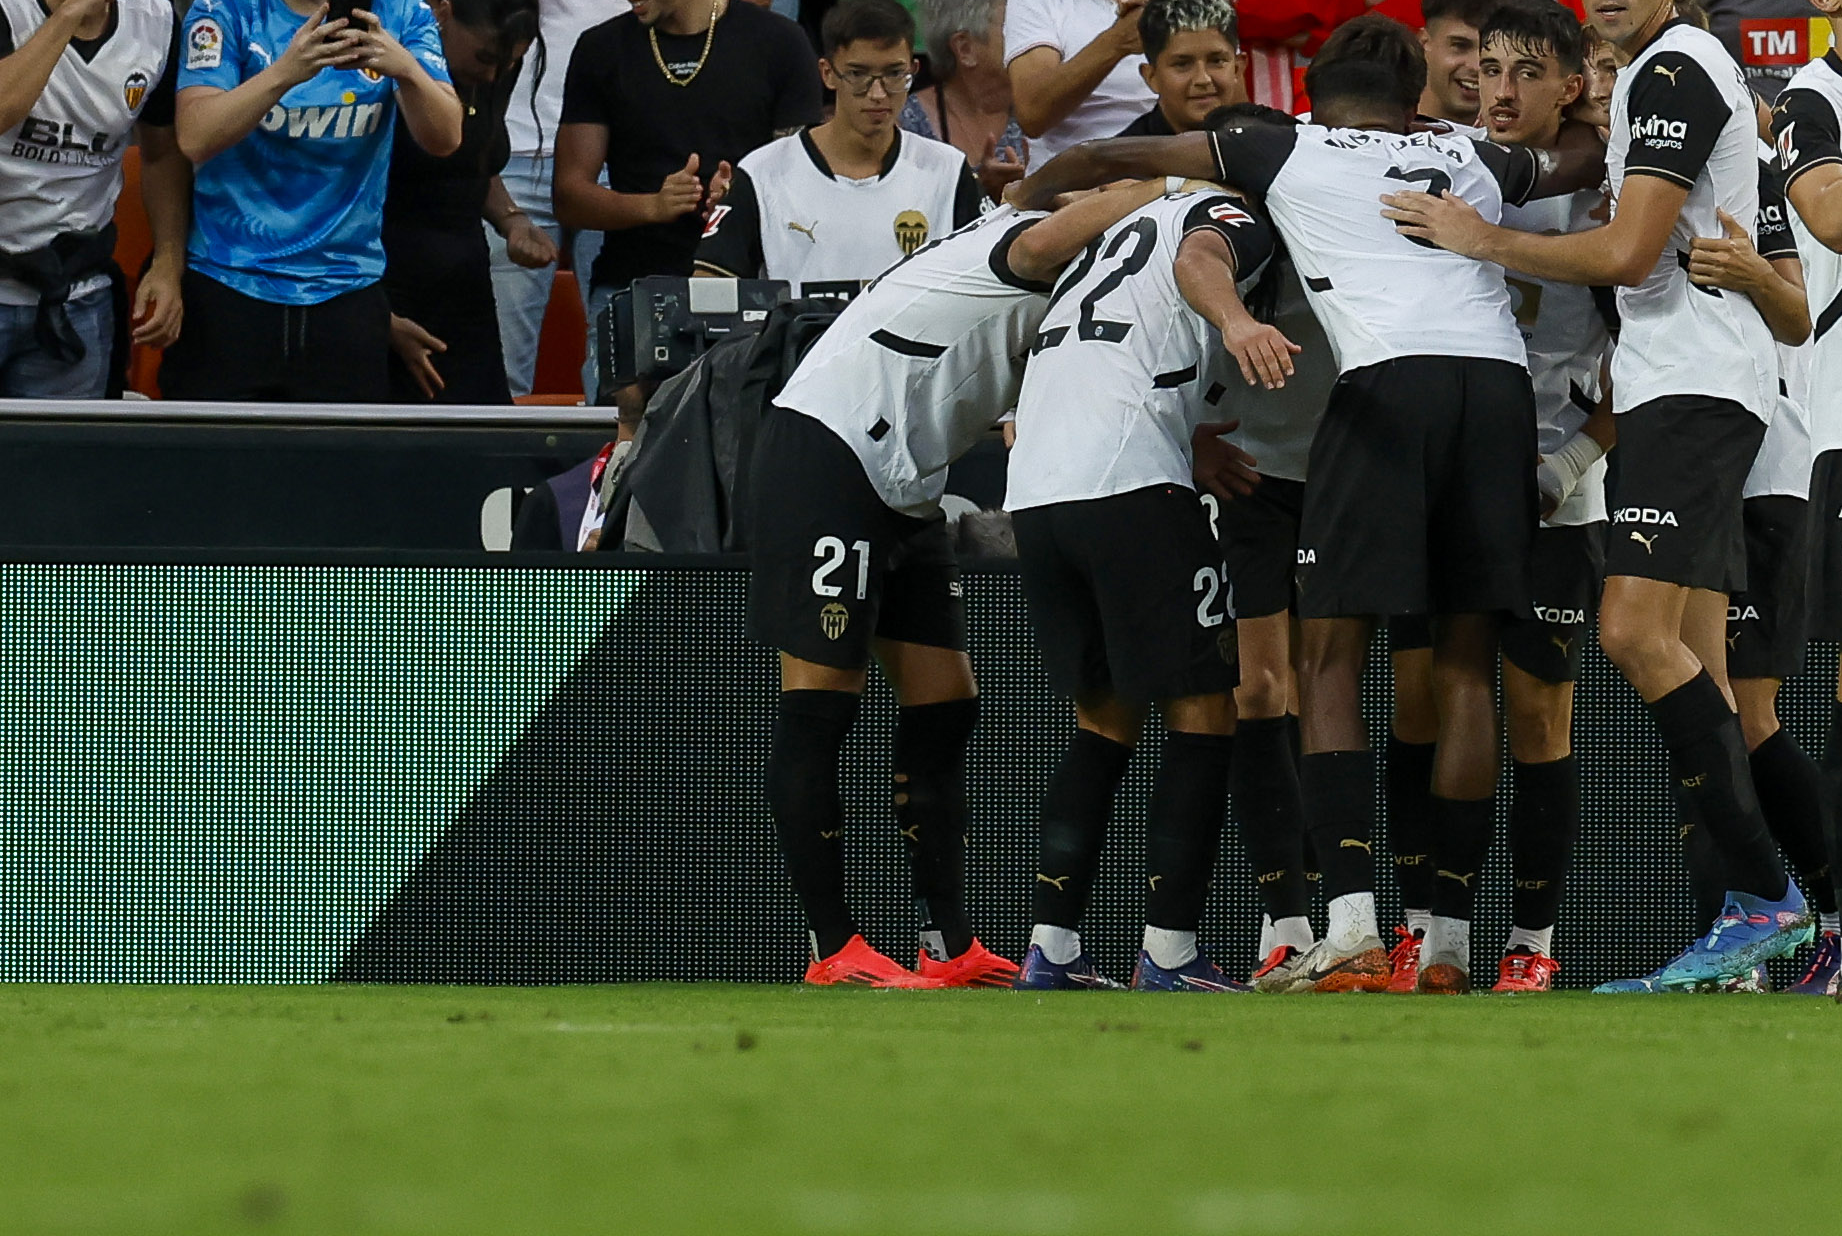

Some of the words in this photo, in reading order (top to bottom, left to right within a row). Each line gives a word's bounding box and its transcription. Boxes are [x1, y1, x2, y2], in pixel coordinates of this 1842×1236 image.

[1748, 30, 1797, 56] TM
[11, 143, 60, 164] BOLD
[1645, 138, 1683, 150] seguros
[812, 535, 870, 600] 21
